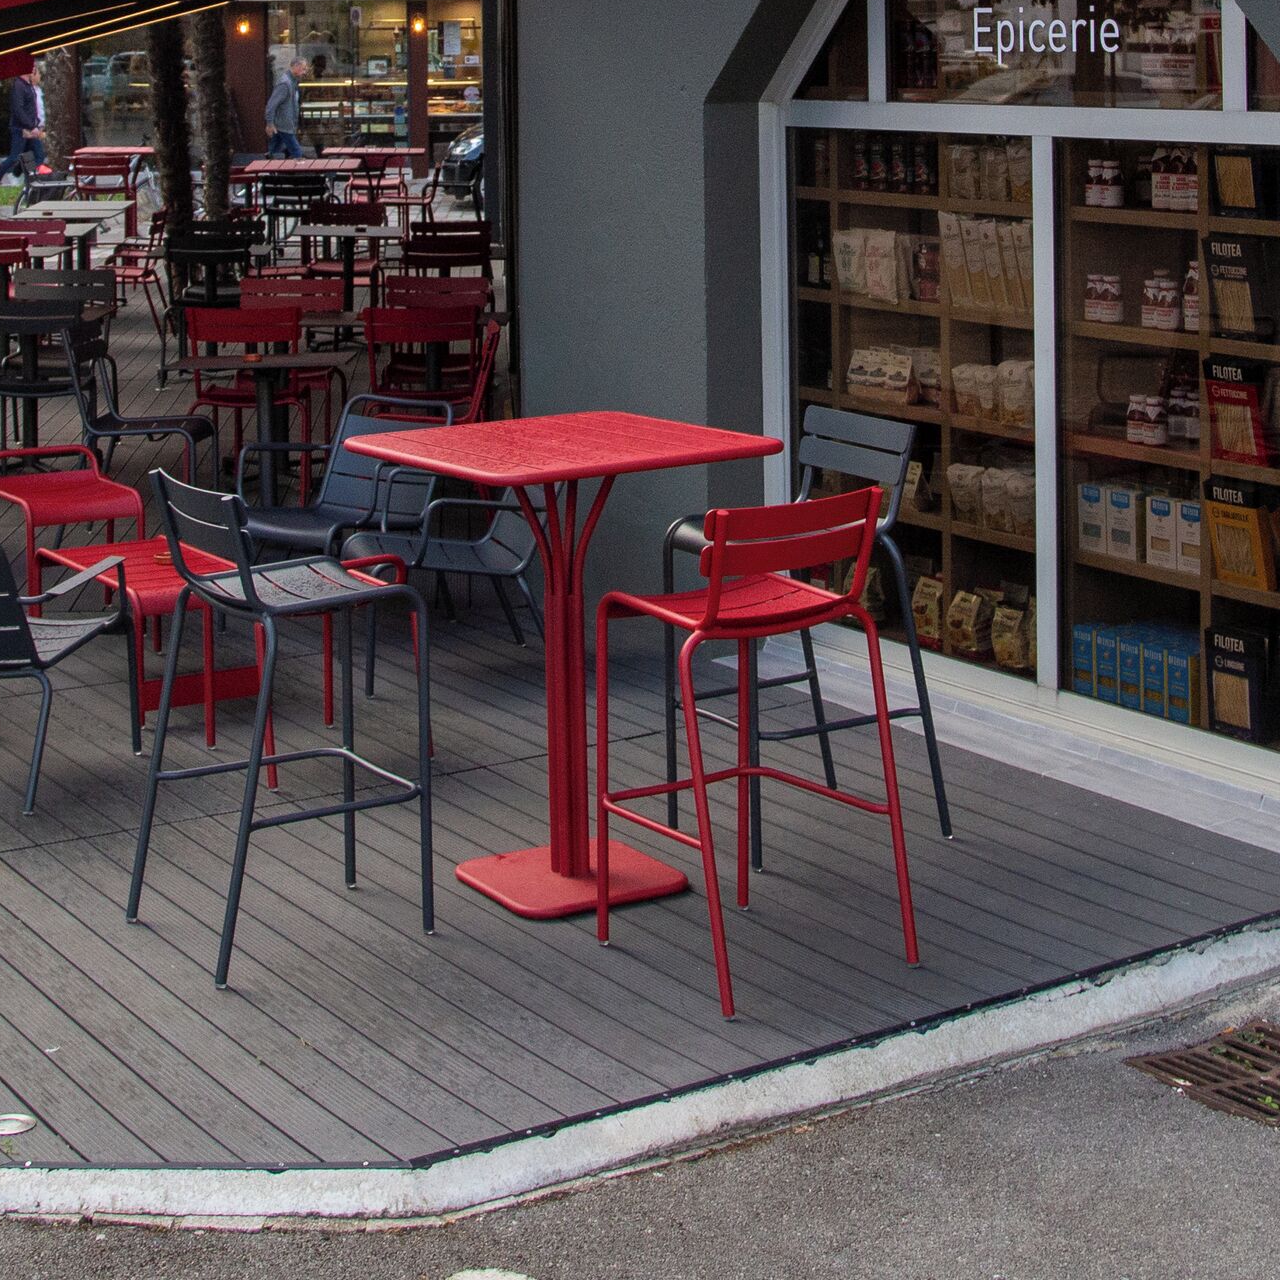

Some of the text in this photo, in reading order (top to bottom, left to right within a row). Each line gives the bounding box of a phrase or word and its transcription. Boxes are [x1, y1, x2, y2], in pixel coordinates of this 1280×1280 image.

[972, 5, 1121, 65] Epicerie
[1211, 242, 1242, 257] FILOTEA
[1212, 365, 1243, 381] FILOTEA
[1213, 486, 1244, 504] FILOTEA
[1214, 634, 1245, 653] FILOTEA
